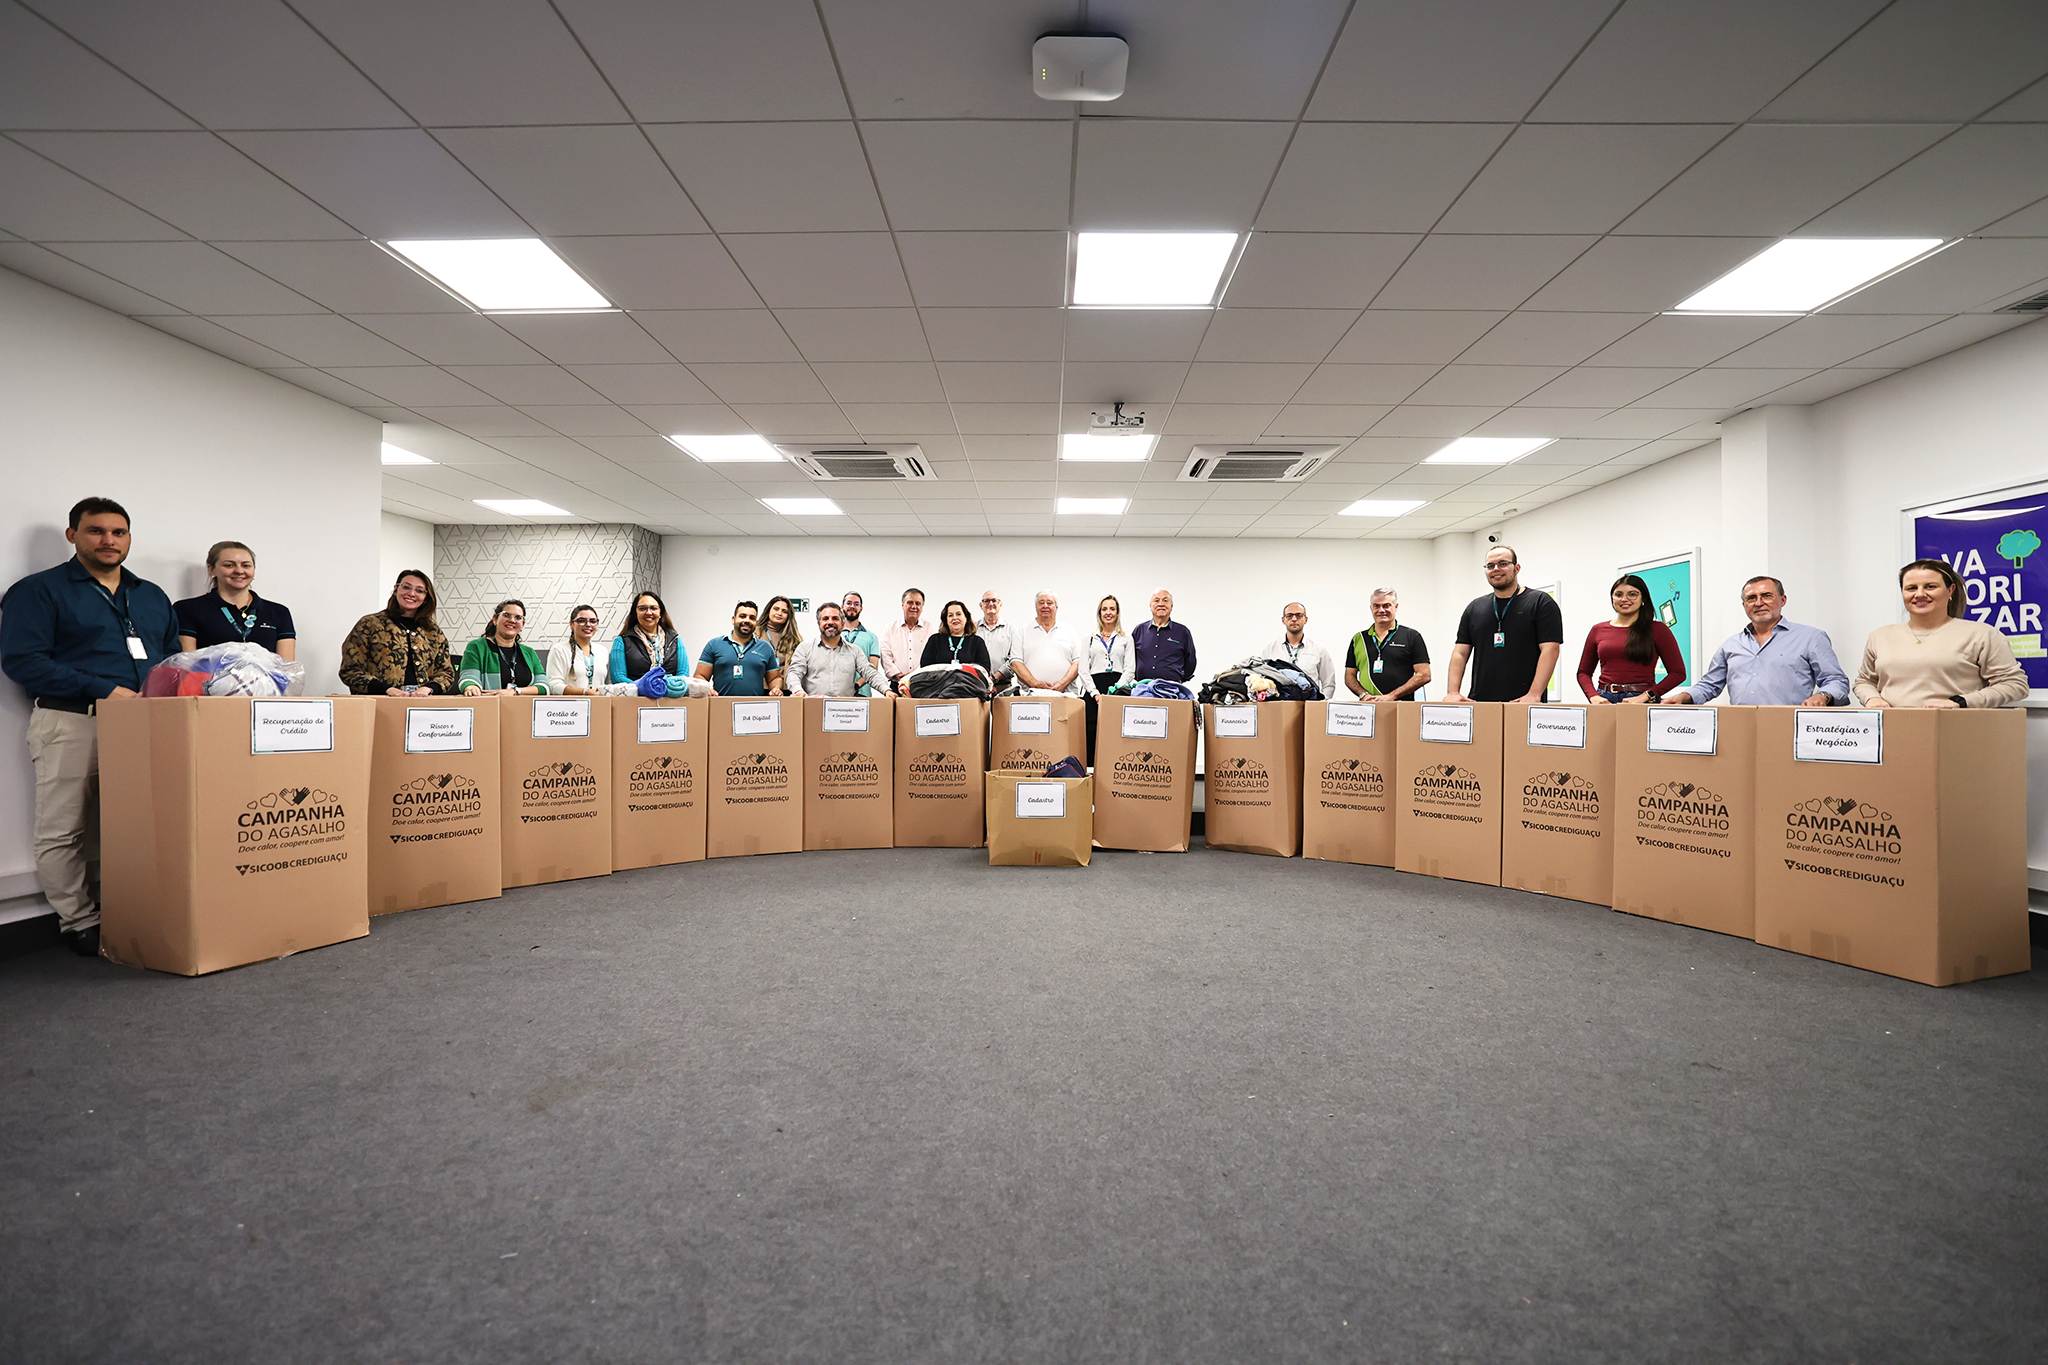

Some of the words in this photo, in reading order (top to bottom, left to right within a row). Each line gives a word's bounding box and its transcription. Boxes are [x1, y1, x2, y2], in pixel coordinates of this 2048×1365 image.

[1941, 549, 1986, 577] VA
[1970, 603, 2043, 632] ZAR
[1537, 723, 1576, 731] Governança
[1667, 726, 1696, 734] Crédito
[1806, 725, 1860, 735] Estratégias
[1815, 738, 1858, 747] Negócios
[727, 766, 787, 776] CAMPANHA
[820, 764, 878, 772] CAMPANHA
[910, 764, 966, 772] CAMPANHA
[1001, 761, 1052, 769] CAMPANHA
[1114, 762, 1172, 774] CAMPANHA
[630, 770, 692, 781] CAMPANHA
[742, 776, 788, 784] AGASALHO
[834, 773, 878, 781] AGASALHO
[1114, 772, 1126, 780] DO
[1128, 775, 1172, 783] AGASALHO
[1215, 770, 1268, 779] CAMPANHA
[1322, 771, 1383, 783] CAMPANHA
[523, 776, 596, 789] CAMPANHA
[630, 783, 643, 791] DO
[647, 780, 692, 790] AGASALHO
[1321, 781, 1333, 789] DO
[1336, 783, 1383, 792] AGASALHO
[1414, 777, 1481, 791] CAMPANHA
[393, 788, 480, 805] CAMPANHA
[523, 791, 539, 800] DO
[542, 788, 596, 799] AGASALHO
[1414, 788, 1427, 796] DO
[1430, 790, 1481, 801] AGASALHO
[1524, 785, 1599, 802] CAMPANHA
[392, 807, 412, 817] DO
[417, 801, 481, 816] AGASALHO
[1523, 798, 1538, 806] DO
[1541, 800, 1599, 813] AGASALHO
[1639, 796, 1729, 817] CAMPANHA
[238, 805, 344, 827] CAMPANHA
[1638, 810, 1655, 820] DO
[1659, 812, 1729, 830] AGASALHO
[238, 829, 262, 843] DO
[268, 821, 345, 840] AGASALHO
[1787, 813, 1901, 839] CAMPANHA
[1668, 826, 1692, 836] coopere
[1707, 831, 1728, 839] amor!
[238, 845, 256, 853] Doe
[257, 842, 278, 851] calor,
[280, 839, 309, 850] coopere
[1786, 829, 1807, 841] DO
[1812, 832, 1901, 854] AGASALHO
[1787, 842, 1801, 850] Doe
[1802, 845, 1822, 854] calor,
[1823, 848, 1854, 859] coopere
[1875, 855, 1901, 865] amor!
